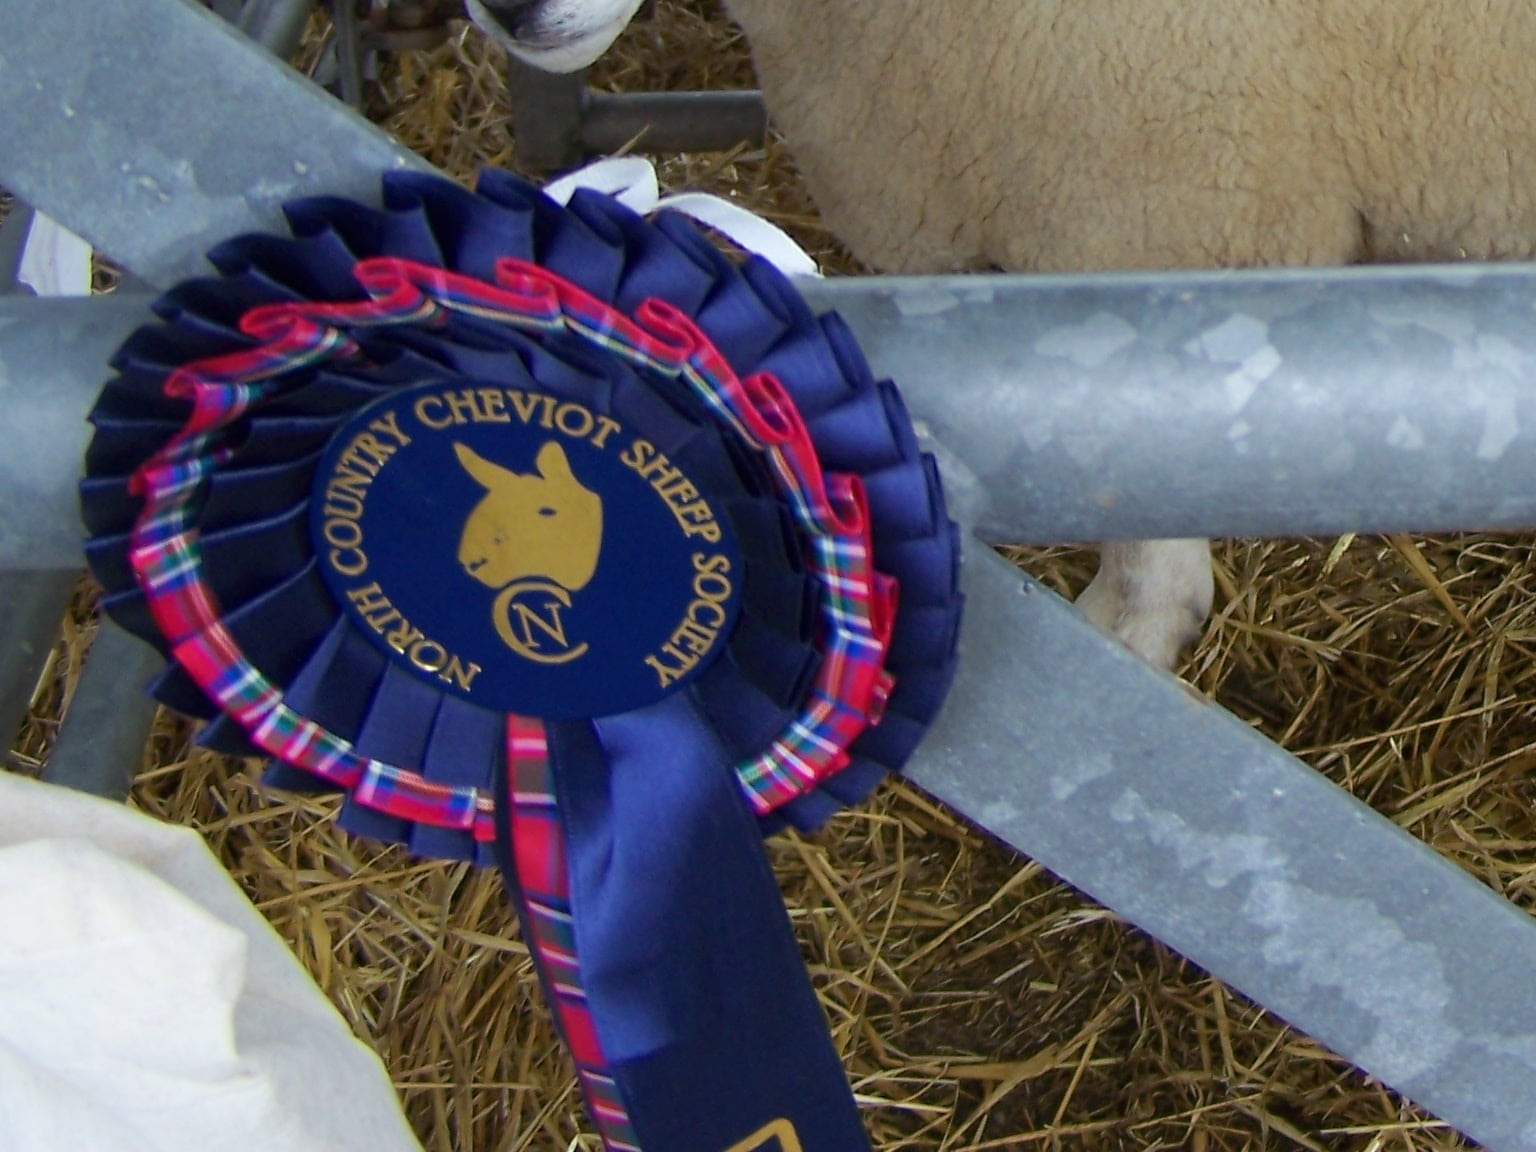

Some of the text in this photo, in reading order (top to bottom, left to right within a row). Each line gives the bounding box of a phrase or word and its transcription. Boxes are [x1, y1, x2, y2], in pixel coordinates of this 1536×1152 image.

[323, 388, 732, 692] NORTH COUNTRY CHEVIOT SHEEP SOCIETY
